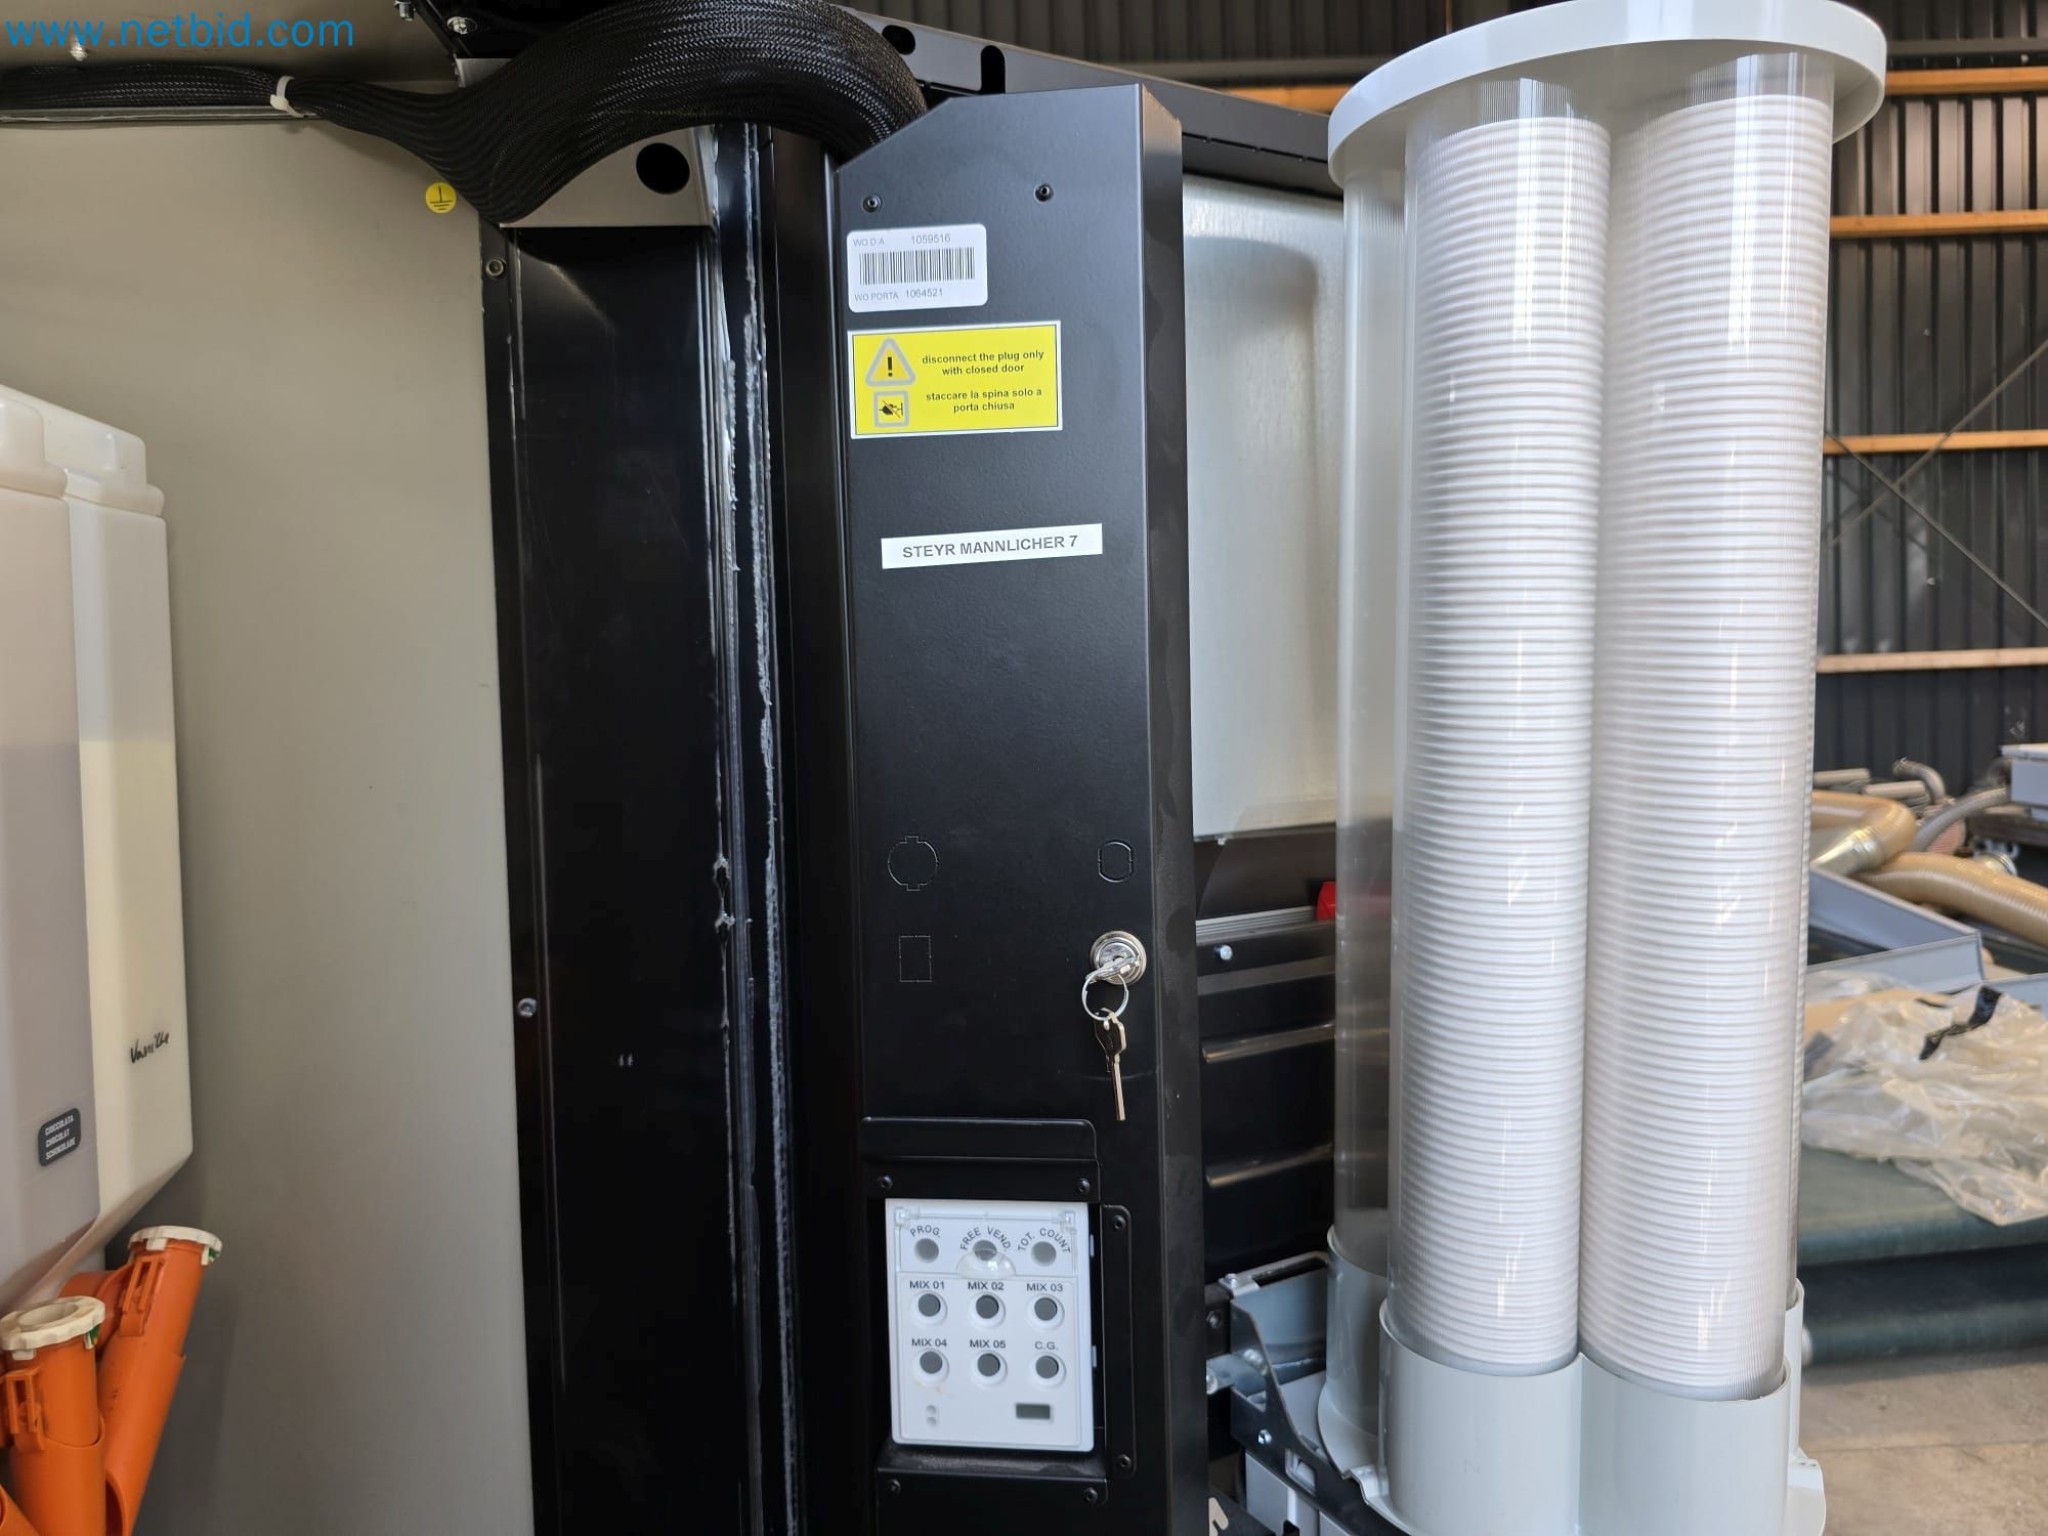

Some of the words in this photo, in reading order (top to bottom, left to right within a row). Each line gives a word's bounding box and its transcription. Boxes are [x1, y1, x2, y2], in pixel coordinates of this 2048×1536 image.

[853, 239, 868, 247] WO
[911, 233, 951, 245] 1059516
[854, 292, 868, 301] WO
[870, 291, 899, 300] PORTA
[905, 288, 943, 298] 1064521
[922, 353, 977, 364] disconnect
[979, 352, 995, 361] the
[998, 351, 1020, 363] plug
[1022, 350, 1044, 361] only
[942, 366, 963, 376] with
[965, 364, 998, 374] closed
[1001, 363, 1024, 373] door
[926, 392, 967, 401] staccare
[970, 390, 979, 399] la
[982, 389, 1009, 400] spina
[1012, 388, 1033, 397] solo
[953, 403, 979, 414] porta
[982, 402, 1015, 411] chiusa
[902, 543, 955, 558] STEYR
[959, 536, 1065, 555] MANNLICHER
[1068, 535, 1078, 548] 7
[910, 1224, 941, 1238] PROG.
[960, 1227, 982, 1251] FREE
[987, 1226, 1012, 1249] VEND
[1039, 1228, 1071, 1253] COUNT
[909, 1280, 930, 1289] MIX
[932, 1280, 945, 1289] 01
[967, 1281, 989, 1290] MIX
[991, 1281, 1004, 1290] 02
[1026, 1283, 1047, 1292] MIX
[1050, 1283, 1063, 1292] 03
[911, 1338, 933, 1347] MIX
[935, 1338, 947, 1347] 04
[969, 1339, 990, 1348] MIX
[992, 1339, 1006, 1349] 05
[1034, 1341, 1059, 1351] C.G.
